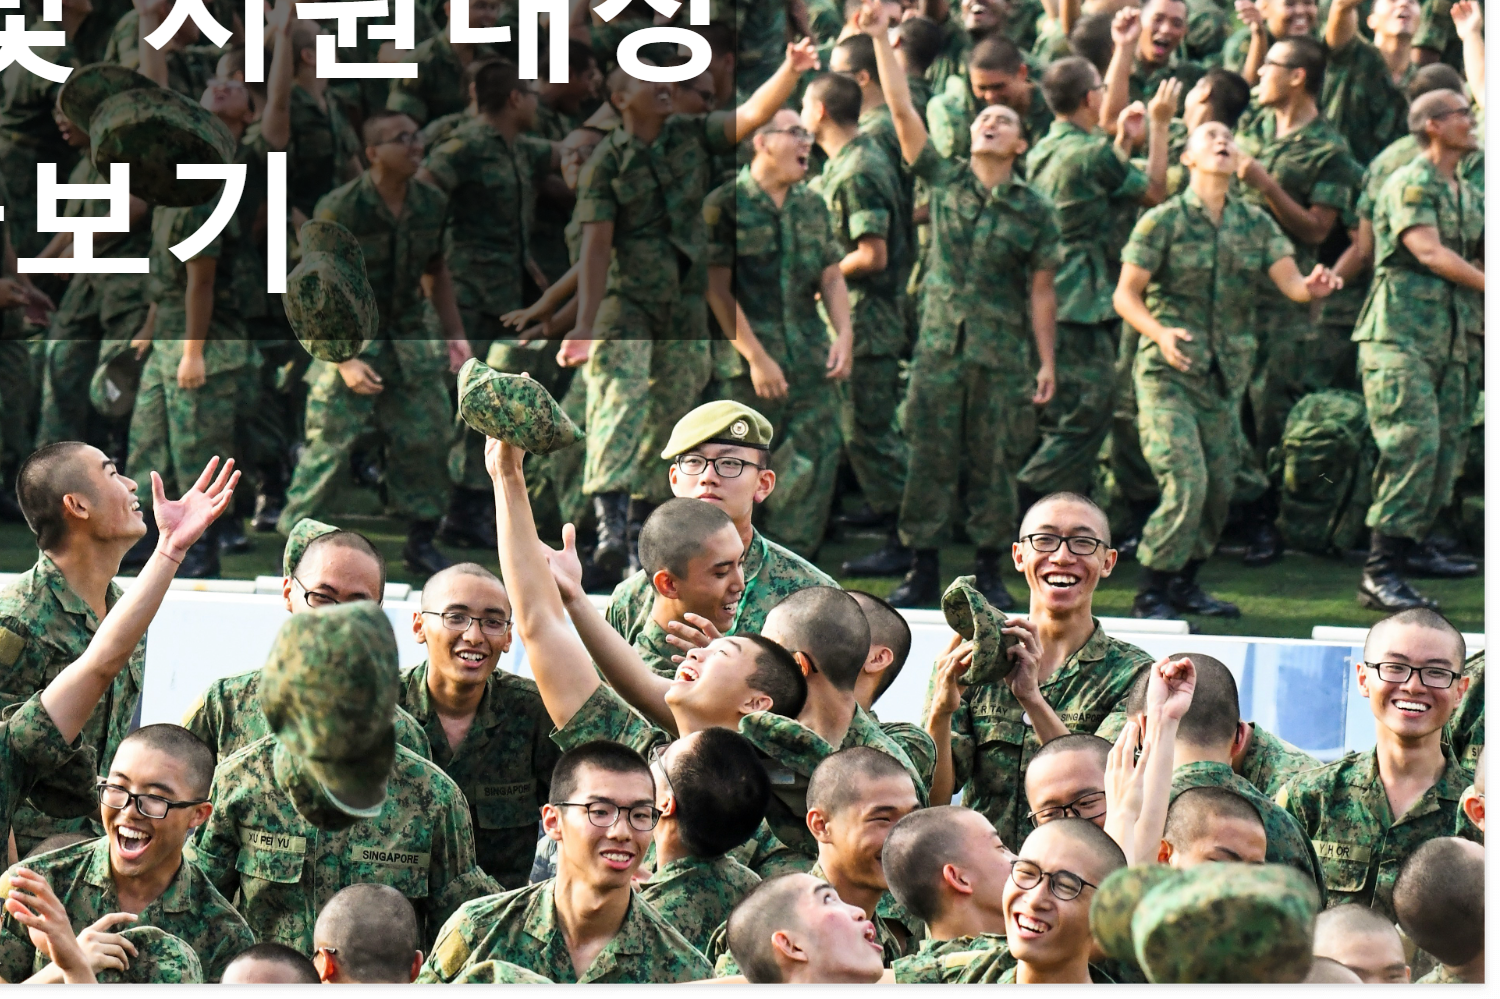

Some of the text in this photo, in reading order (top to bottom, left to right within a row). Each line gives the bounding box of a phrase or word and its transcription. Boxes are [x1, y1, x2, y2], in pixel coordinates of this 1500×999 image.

[260, 835, 274, 846] PEI
[277, 837, 290, 849] YU
[362, 850, 420, 865] SINGAPORE
[1336, 845, 1350, 857] OR
